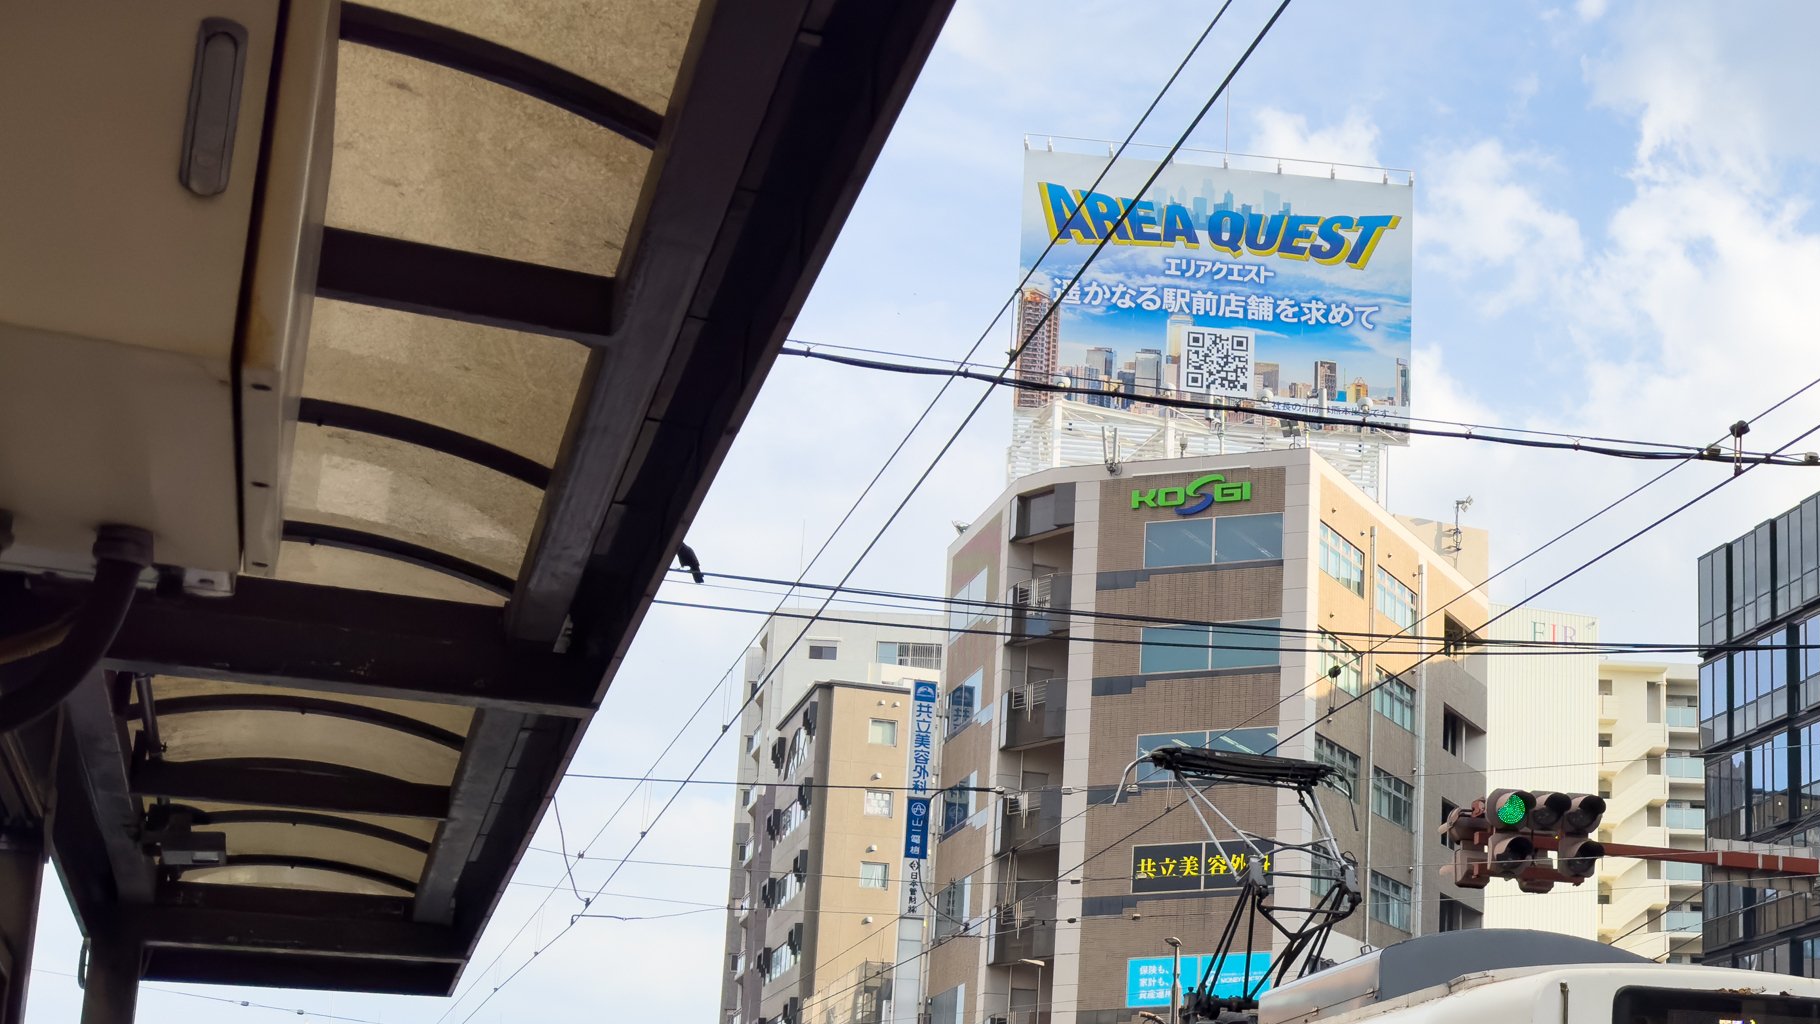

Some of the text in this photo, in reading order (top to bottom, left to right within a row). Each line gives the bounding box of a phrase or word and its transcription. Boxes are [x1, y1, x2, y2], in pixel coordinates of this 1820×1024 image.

[1038, 182, 1401, 270] AREA QUEST
[1164, 258, 1274, 283] エリアクエスト
[912, 702, 933, 796] 共立美容外科
